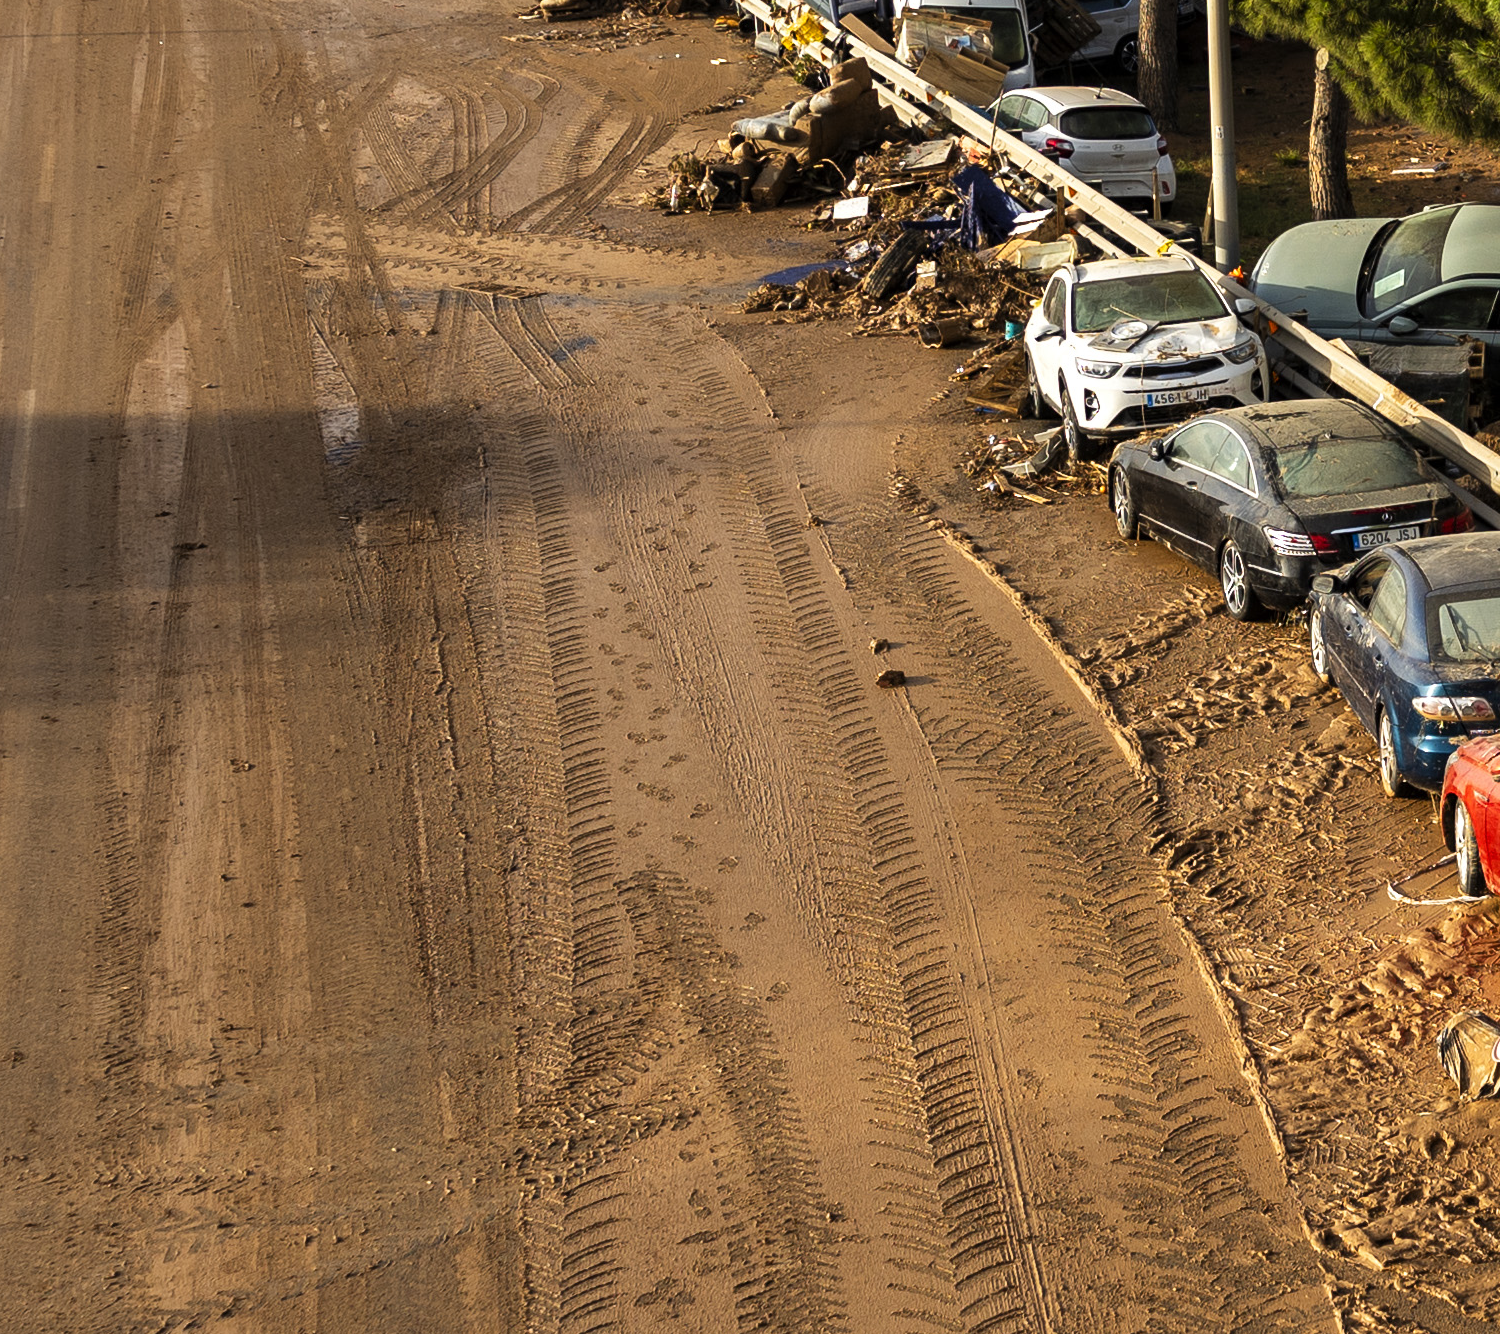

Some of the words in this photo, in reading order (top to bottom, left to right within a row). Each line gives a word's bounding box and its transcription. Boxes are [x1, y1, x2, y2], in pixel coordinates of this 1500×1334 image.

[1154, 392, 1182, 405] 4561
[1361, 531, 1390, 546] 6204
[1396, 529, 1417, 542] JSJ
